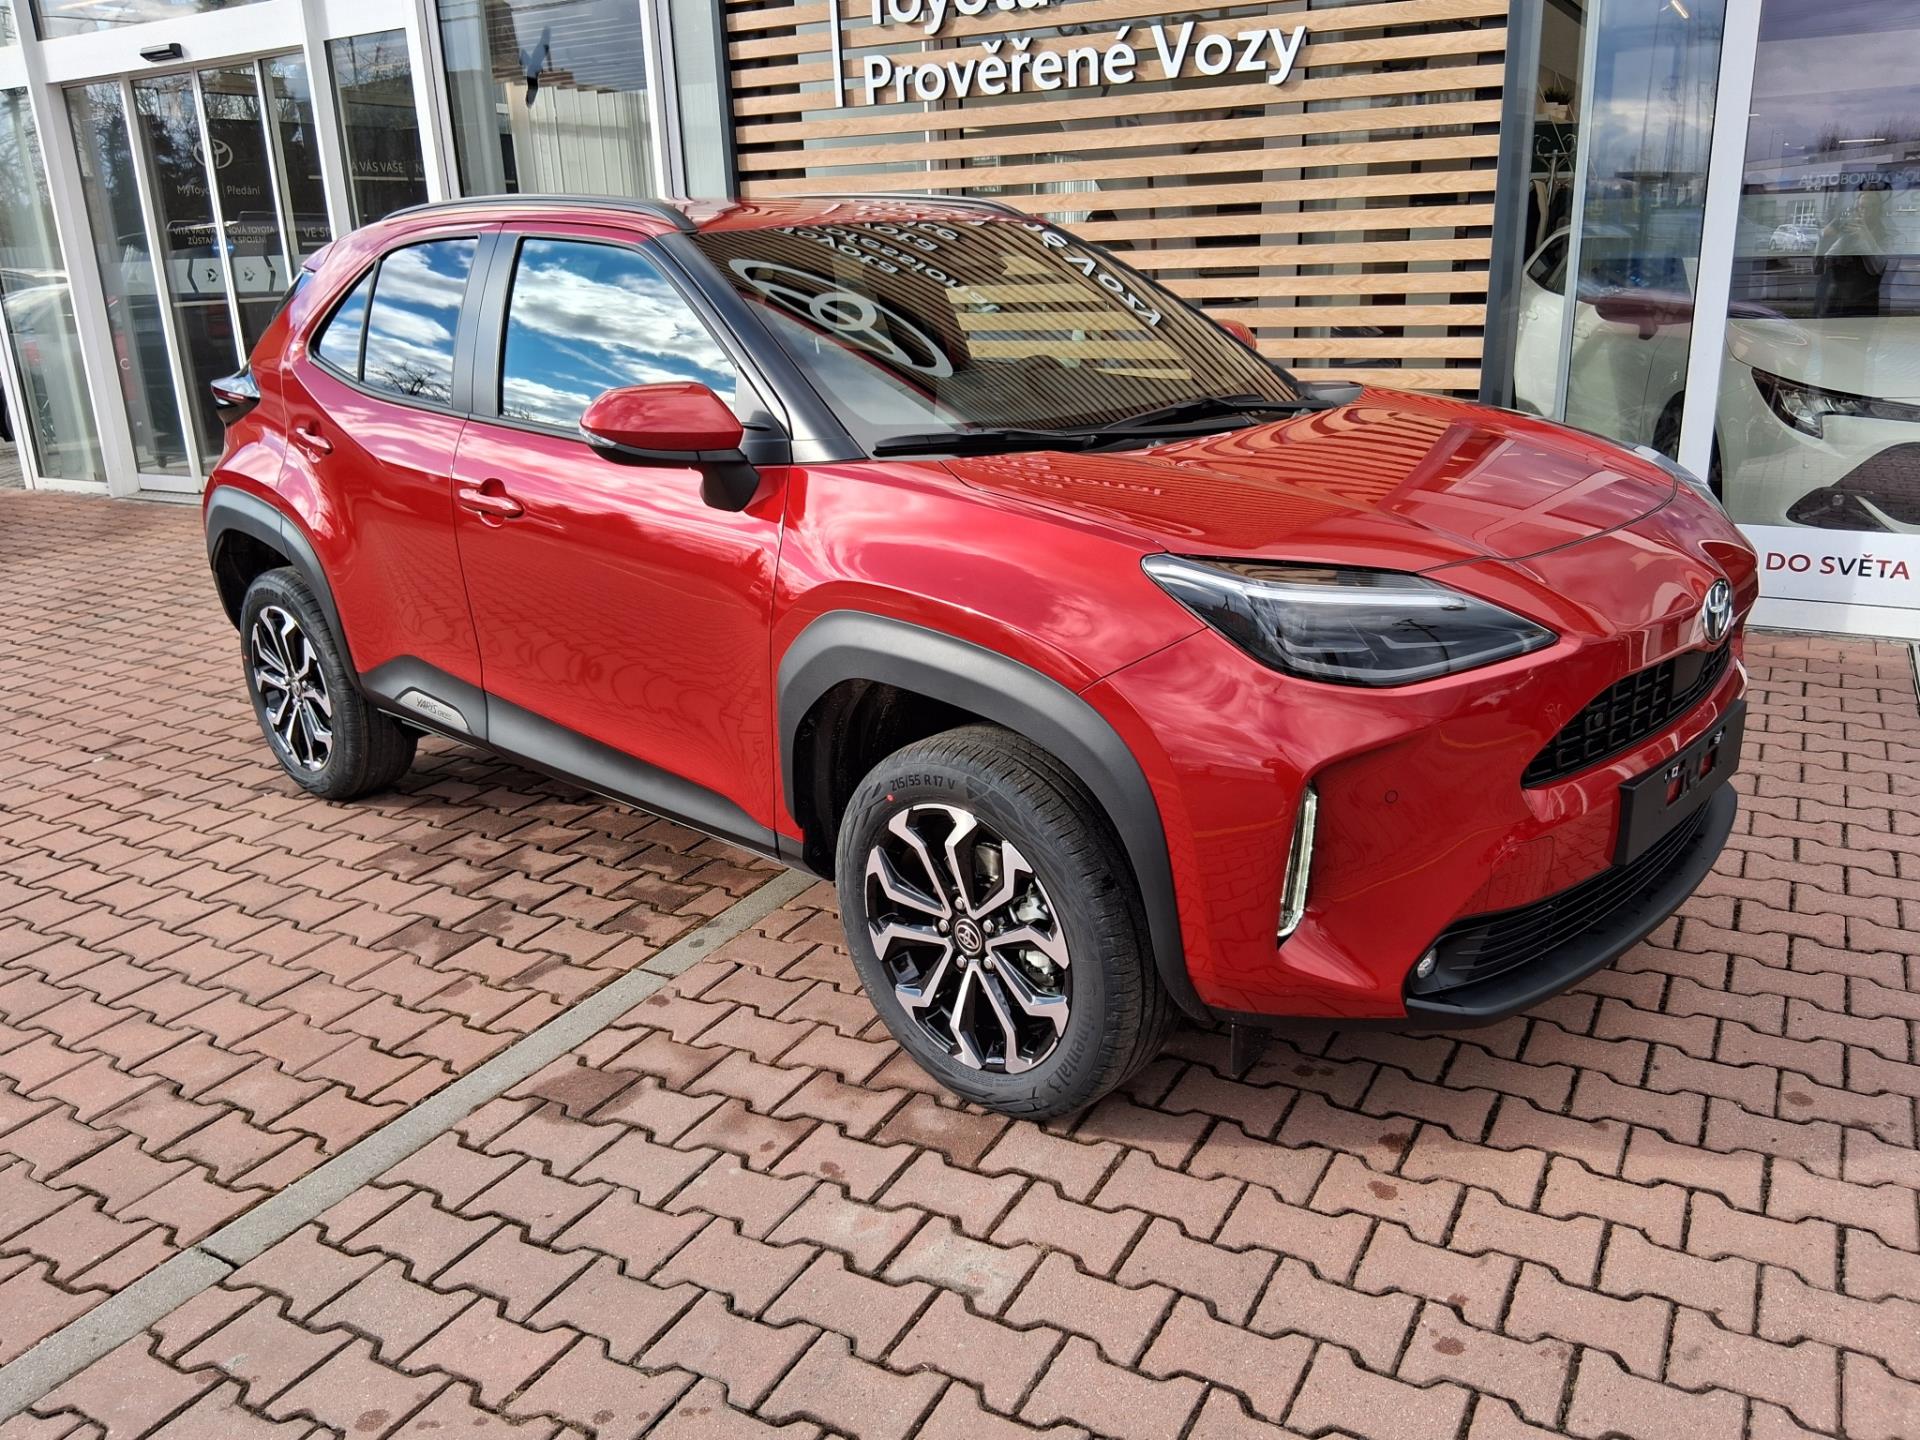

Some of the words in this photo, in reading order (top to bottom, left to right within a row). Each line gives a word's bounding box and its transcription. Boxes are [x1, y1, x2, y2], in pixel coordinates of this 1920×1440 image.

[864, 26, 1136, 105] Prověřené
[1152, 22, 1307, 86] Vozy
[1765, 552, 1811, 573] DO
[1819, 553, 1910, 580] SVĚTA
[889, 774, 921, 791] 215/55
[923, 774, 931, 786] R
[933, 775, 944, 787] 17
[947, 778, 956, 789] V
[1056, 981, 1097, 1088] tinental
